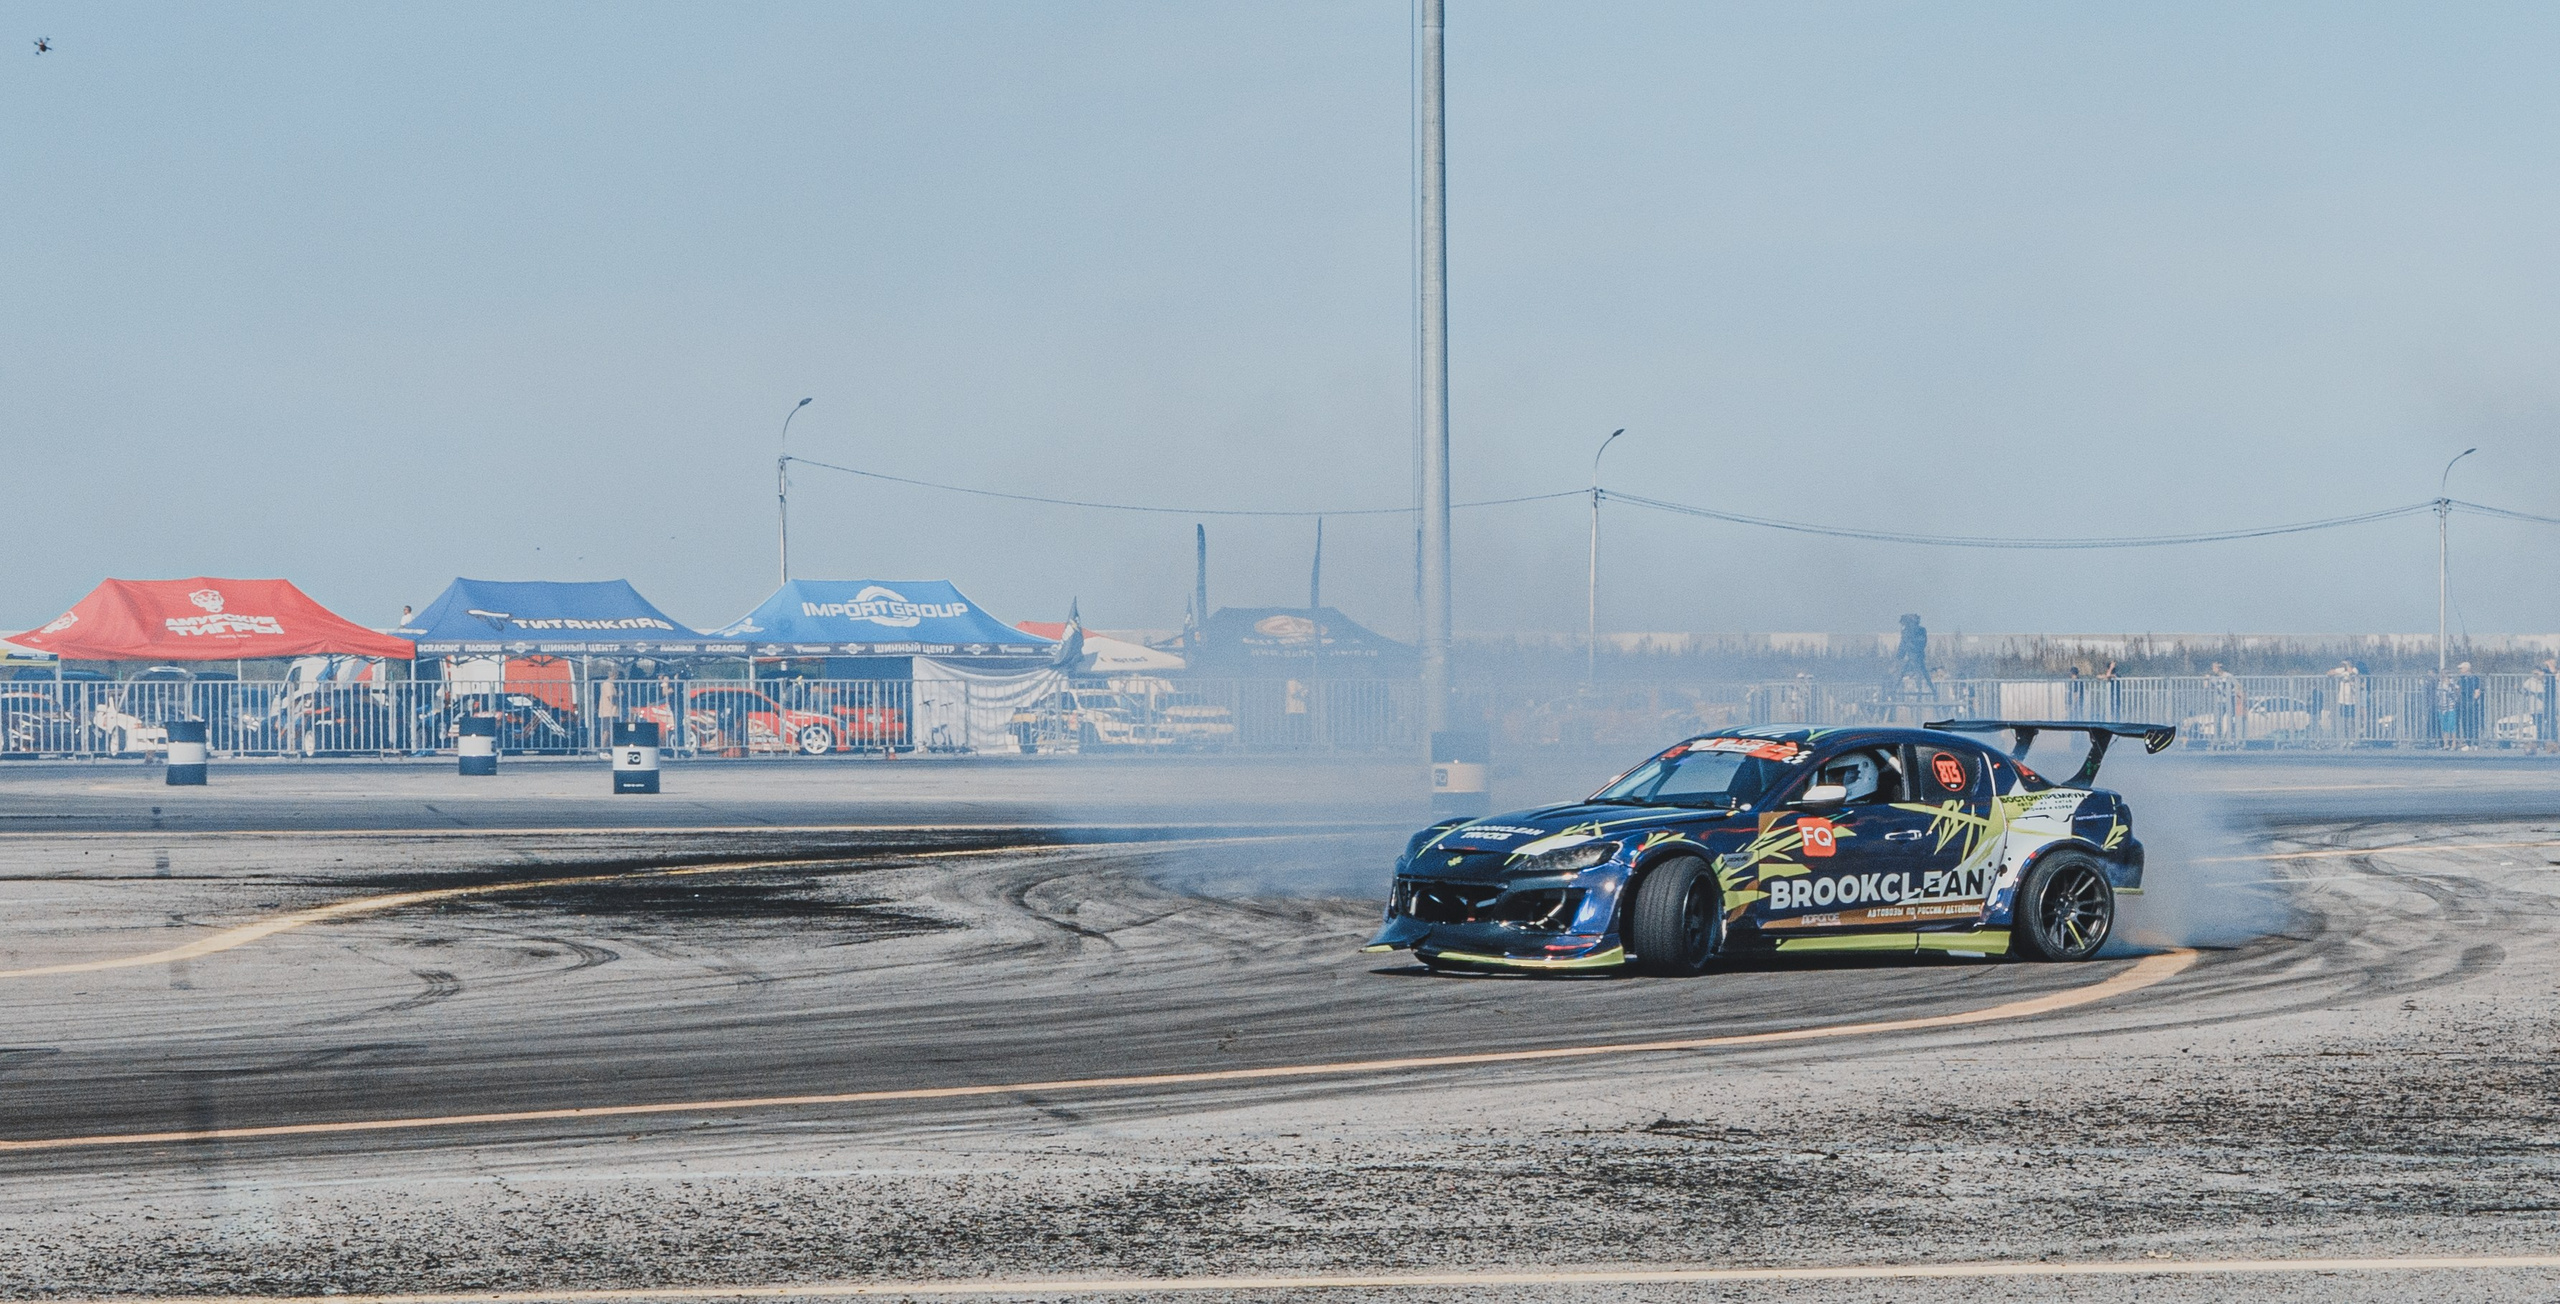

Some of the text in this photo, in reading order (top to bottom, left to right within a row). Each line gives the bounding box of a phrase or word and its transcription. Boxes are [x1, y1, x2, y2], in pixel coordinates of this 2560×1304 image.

[801, 600, 969, 618] IMPORTGROUP
[165, 613, 277, 627] АМУРСКИЕ
[167, 621, 285, 636] ТИГРЫ
[540, 642, 587, 653] ШИННЫЙ
[587, 644, 620, 654] ЦЕНТР
[873, 642, 922, 654] ШИННЫЙ
[922, 644, 955, 655] ЦЕНТР
[1801, 826, 1833, 847] FQ
[1769, 868, 1985, 910] BROOKCLEAN
